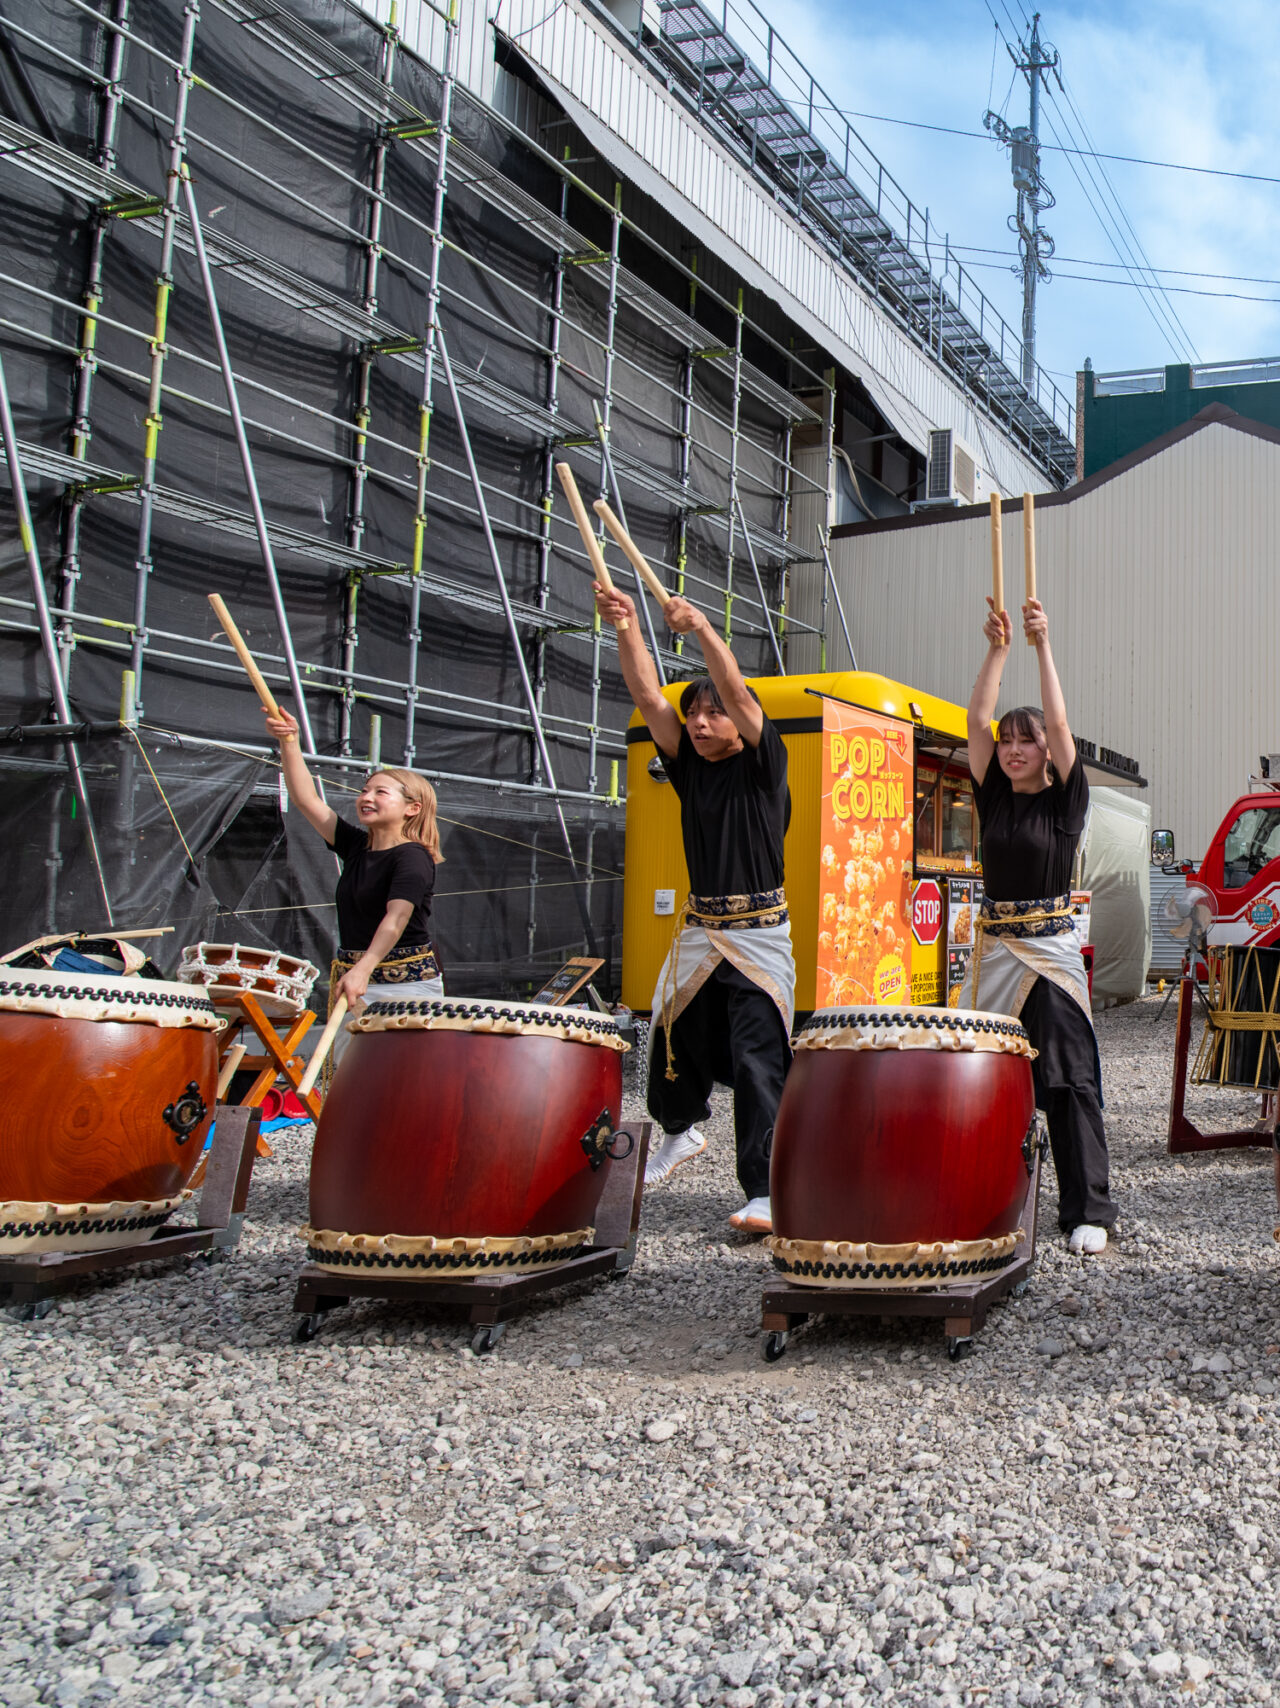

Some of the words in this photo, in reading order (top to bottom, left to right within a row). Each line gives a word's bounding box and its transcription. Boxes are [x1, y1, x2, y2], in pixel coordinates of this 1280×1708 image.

[830, 733, 886, 776] POP
[831, 778, 905, 819] CORN
[914, 900, 941, 925] STOP
[880, 971, 889, 980] we
[891, 965, 902, 975] are
[880, 974, 902, 993] OPEN
